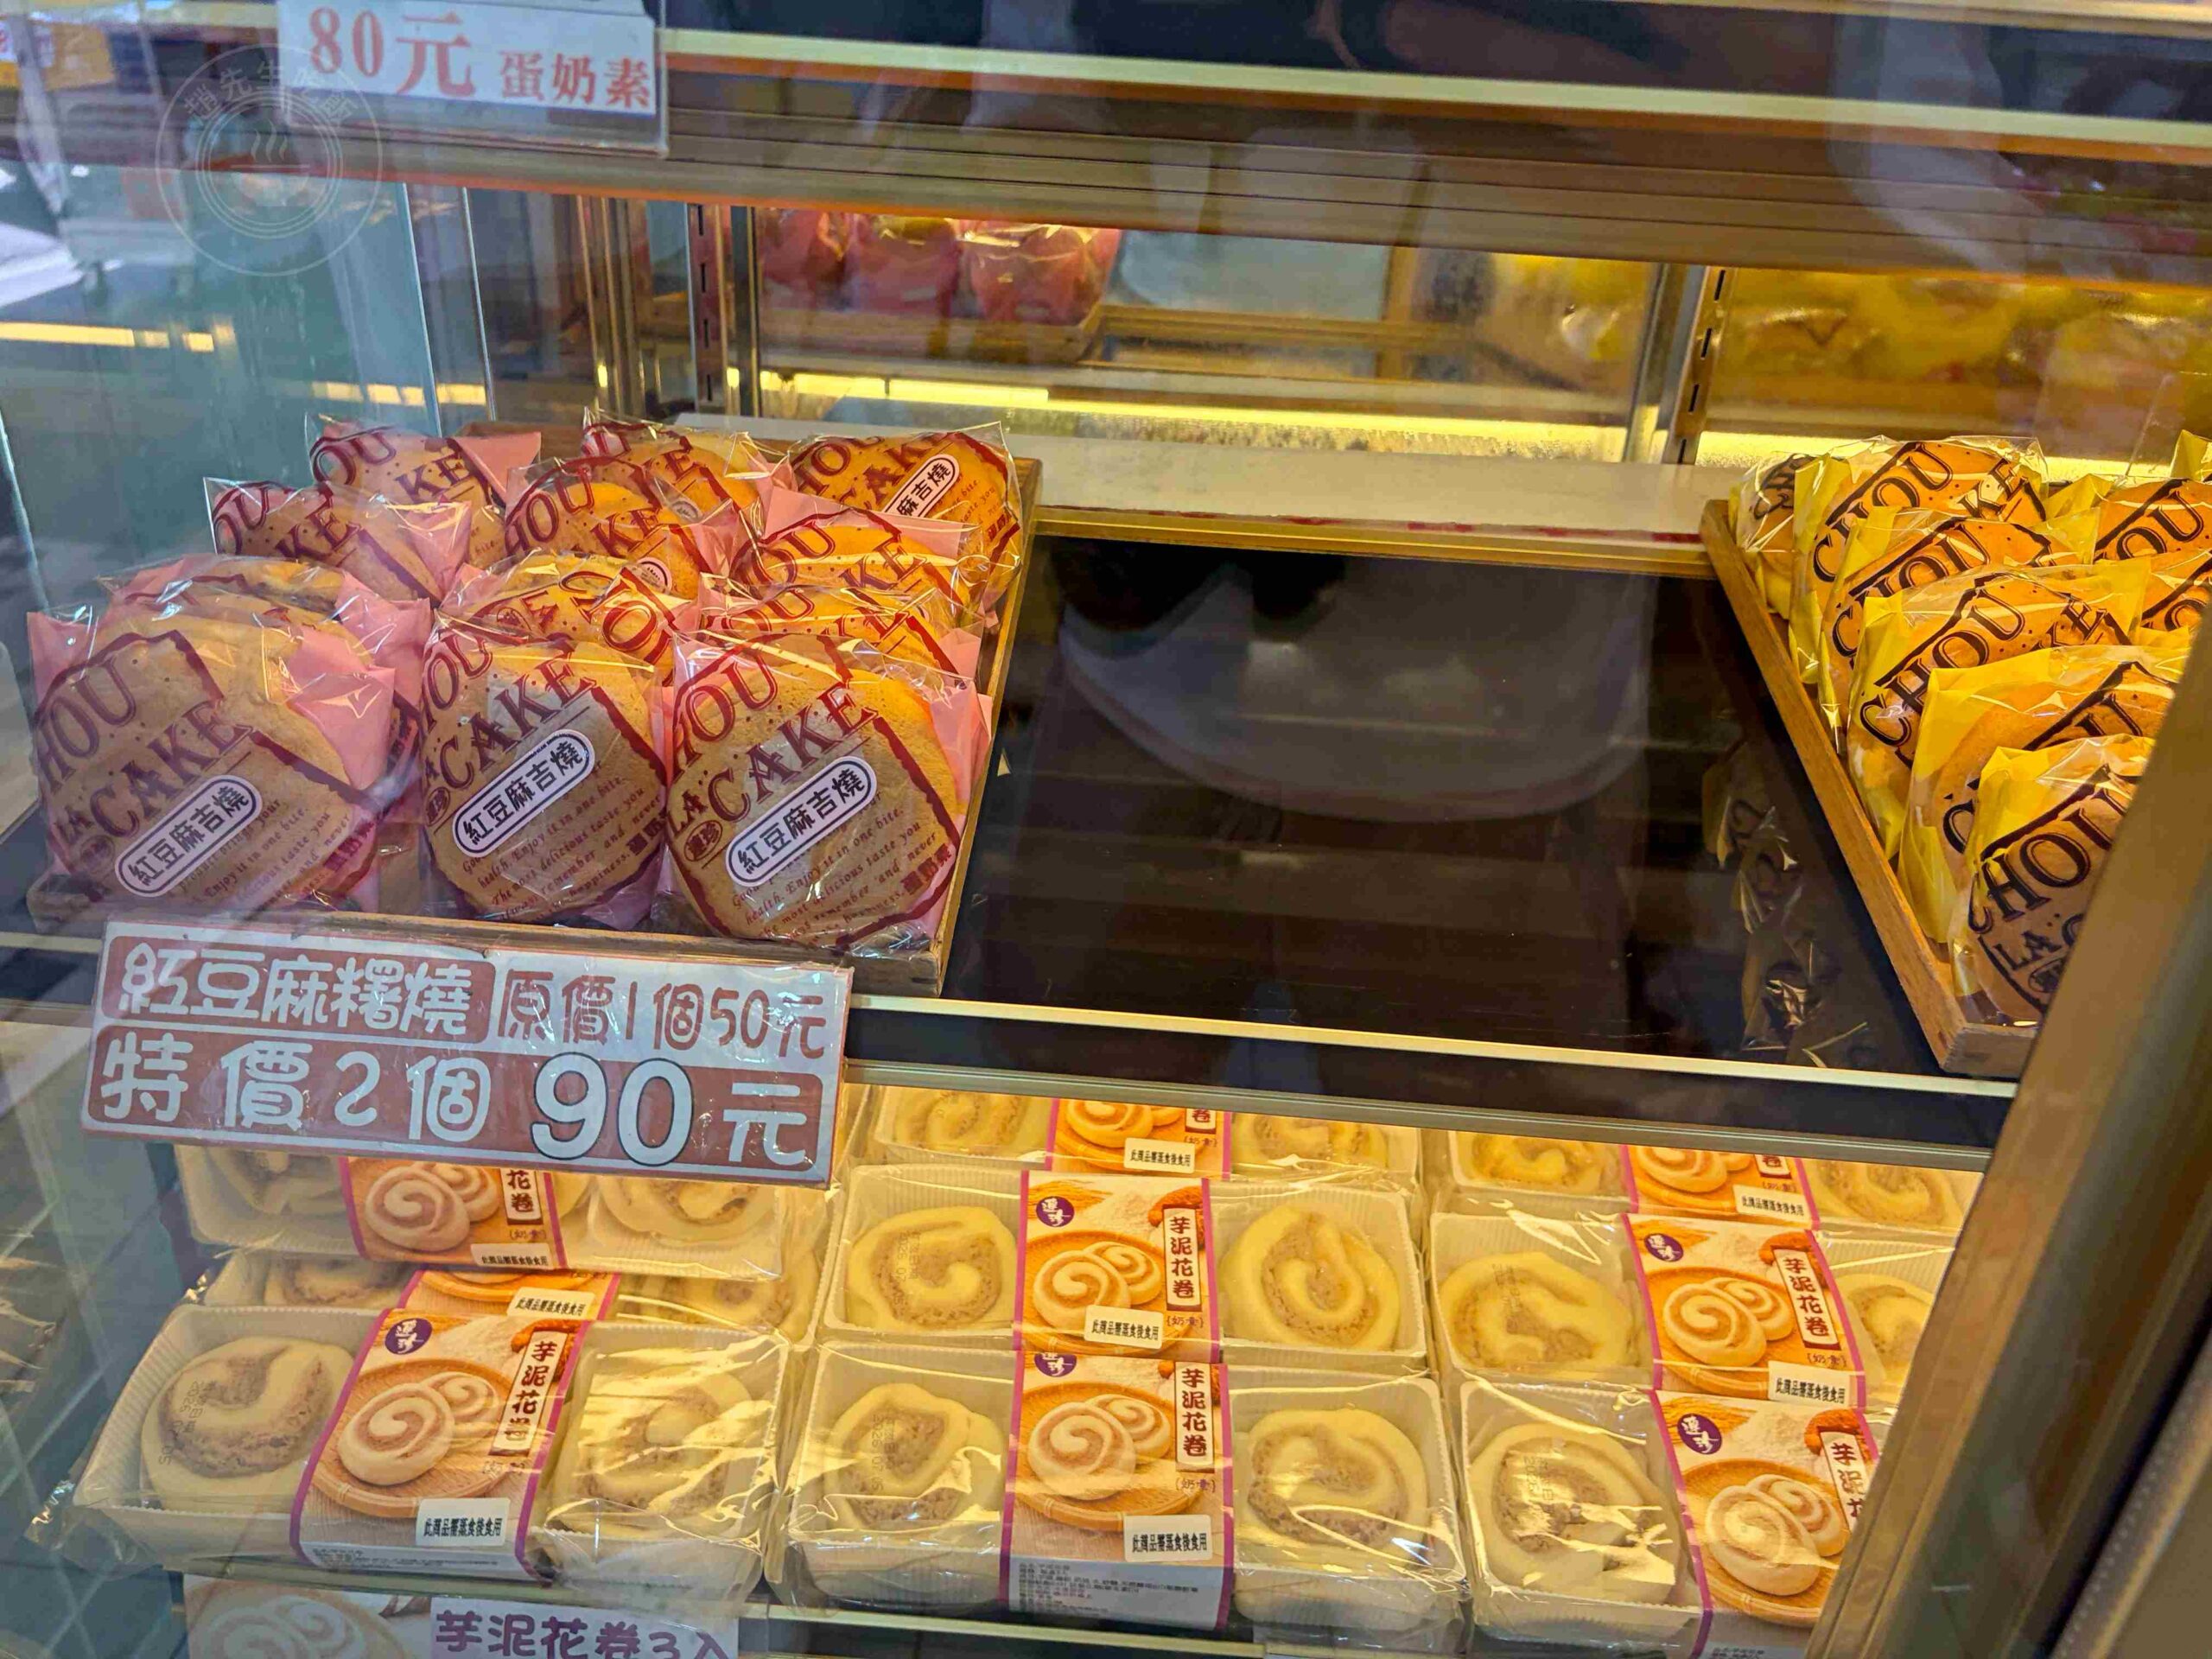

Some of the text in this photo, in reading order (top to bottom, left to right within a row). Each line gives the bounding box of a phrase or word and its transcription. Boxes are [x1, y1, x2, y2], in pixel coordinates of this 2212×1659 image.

[309, 7, 652, 108] 80元 蛋奶素
[313, 431, 396, 486] OU
[395, 450, 474, 503] KE
[896, 462, 950, 517] 麻吉燒
[1958, 458, 2028, 518] KE
[590, 507, 664, 558] KE
[839, 536, 927, 591] KE
[426, 632, 493, 710] OU
[672, 652, 777, 780] HOU
[1859, 588, 2025, 746] CHOU
[38, 659, 137, 789] HOU
[90, 700, 253, 838] CAKE
[439, 652, 597, 789] CAKE
[708, 682, 880, 823] CAKE
[128, 785, 249, 887] 紅豆麻吉燒
[463, 741, 583, 844] 紅豆麻吉燒
[737, 769, 866, 874] 紅豆麻吉燒
[118, 942, 473, 1036] 紅豆麻糬燒
[506, 1169, 535, 1212] 花卷
